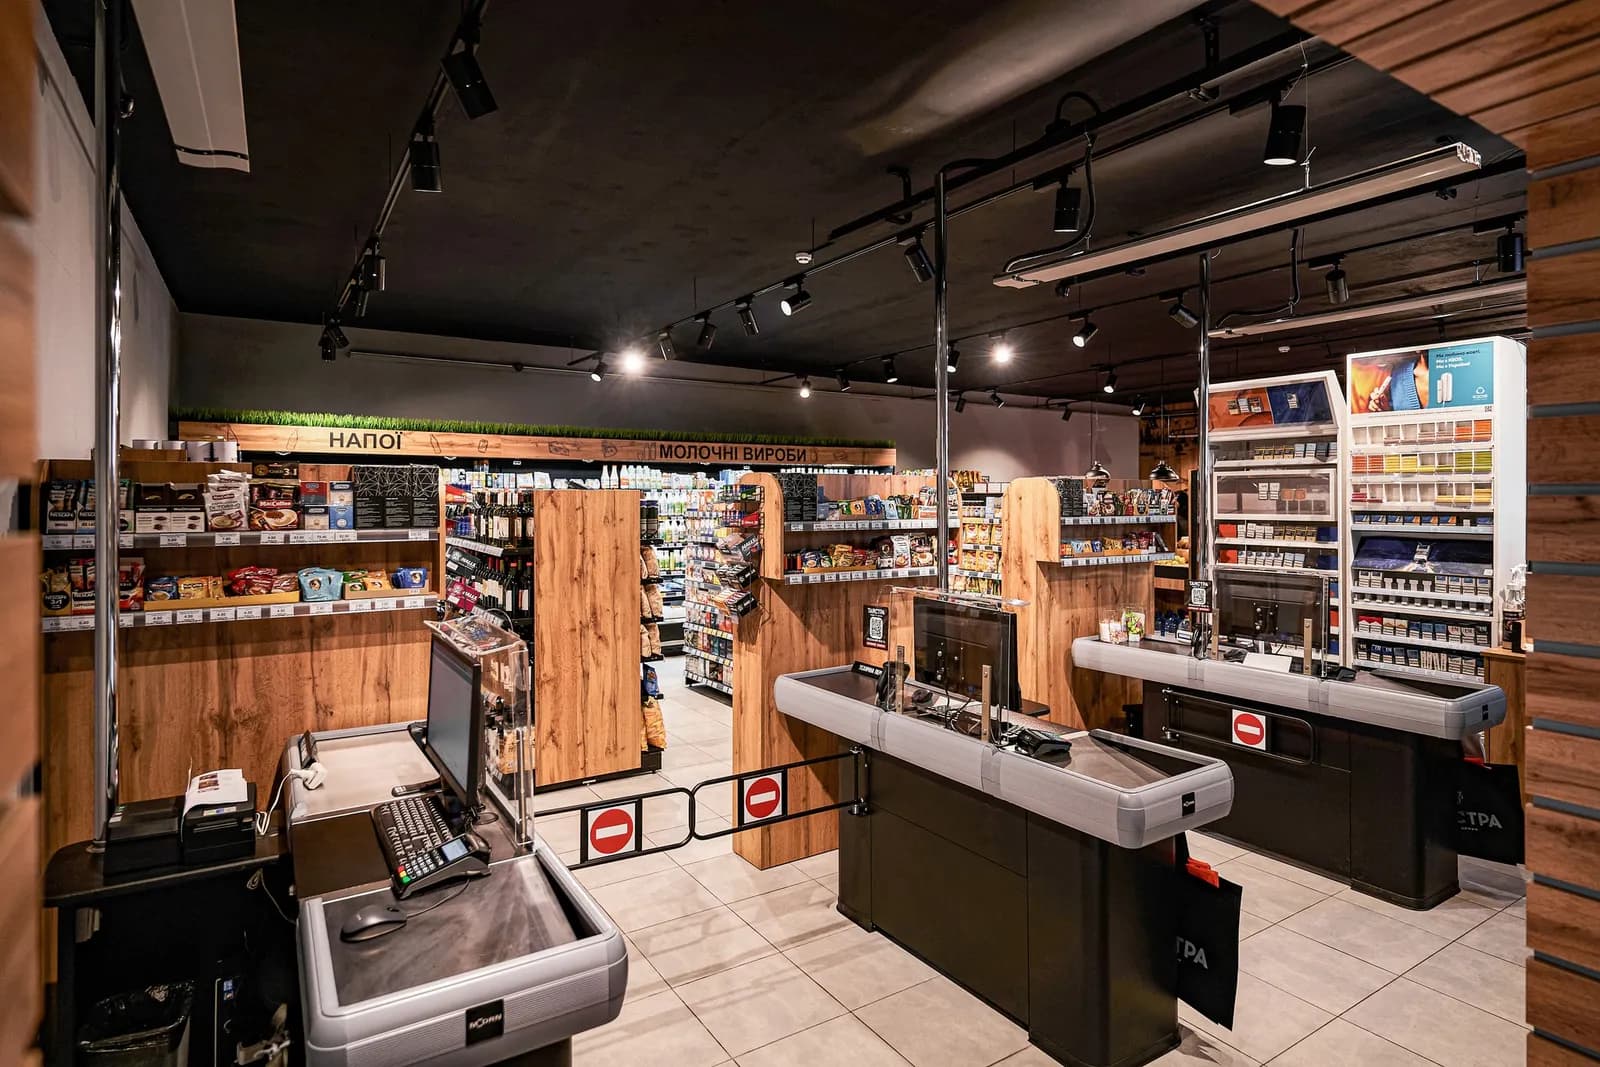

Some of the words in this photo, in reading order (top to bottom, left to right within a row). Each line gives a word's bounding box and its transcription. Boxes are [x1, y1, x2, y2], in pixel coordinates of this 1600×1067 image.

[329, 431, 403, 449] НАПОЇ
[659, 444, 738, 461] МОЛОЧНІ
[743, 447, 806, 462] ВИРОБИ
